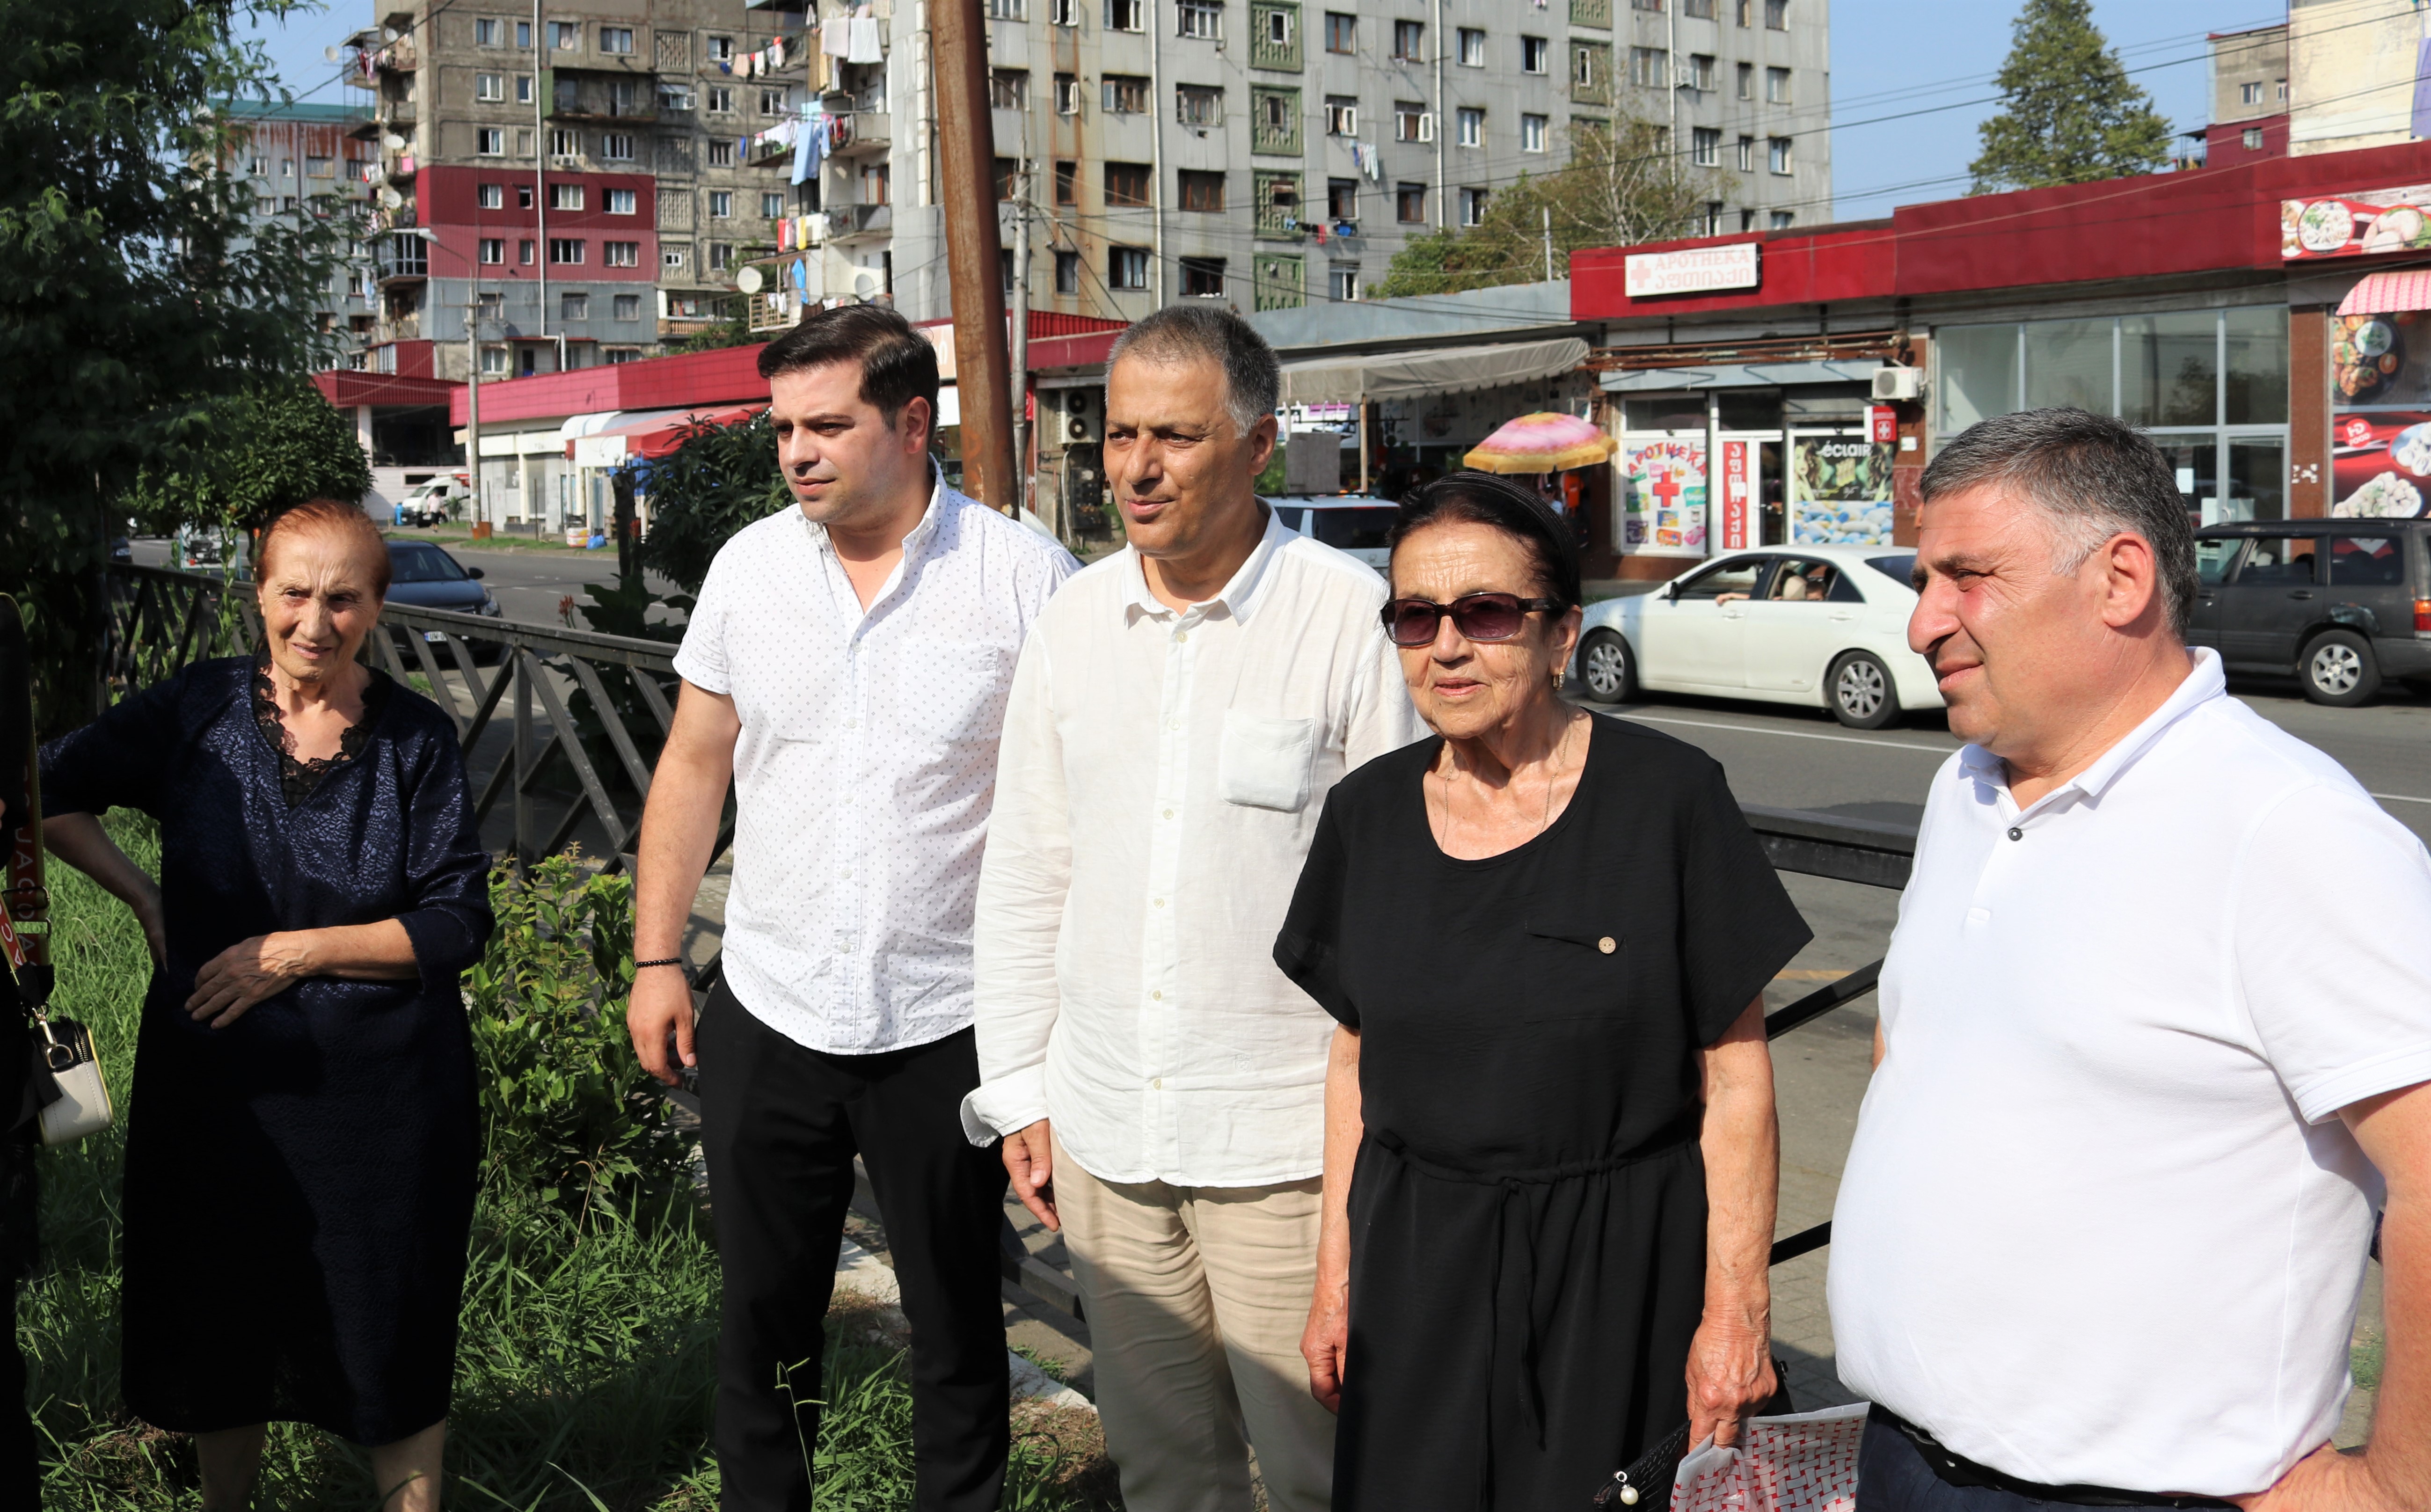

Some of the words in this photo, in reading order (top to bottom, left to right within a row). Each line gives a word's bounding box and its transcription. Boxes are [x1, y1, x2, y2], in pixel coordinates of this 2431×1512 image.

[1655, 249, 1750, 270] APOTHEKA
[1655, 268, 1751, 289] აფთიაქი
[2348, 432, 2372, 446] FOOD
